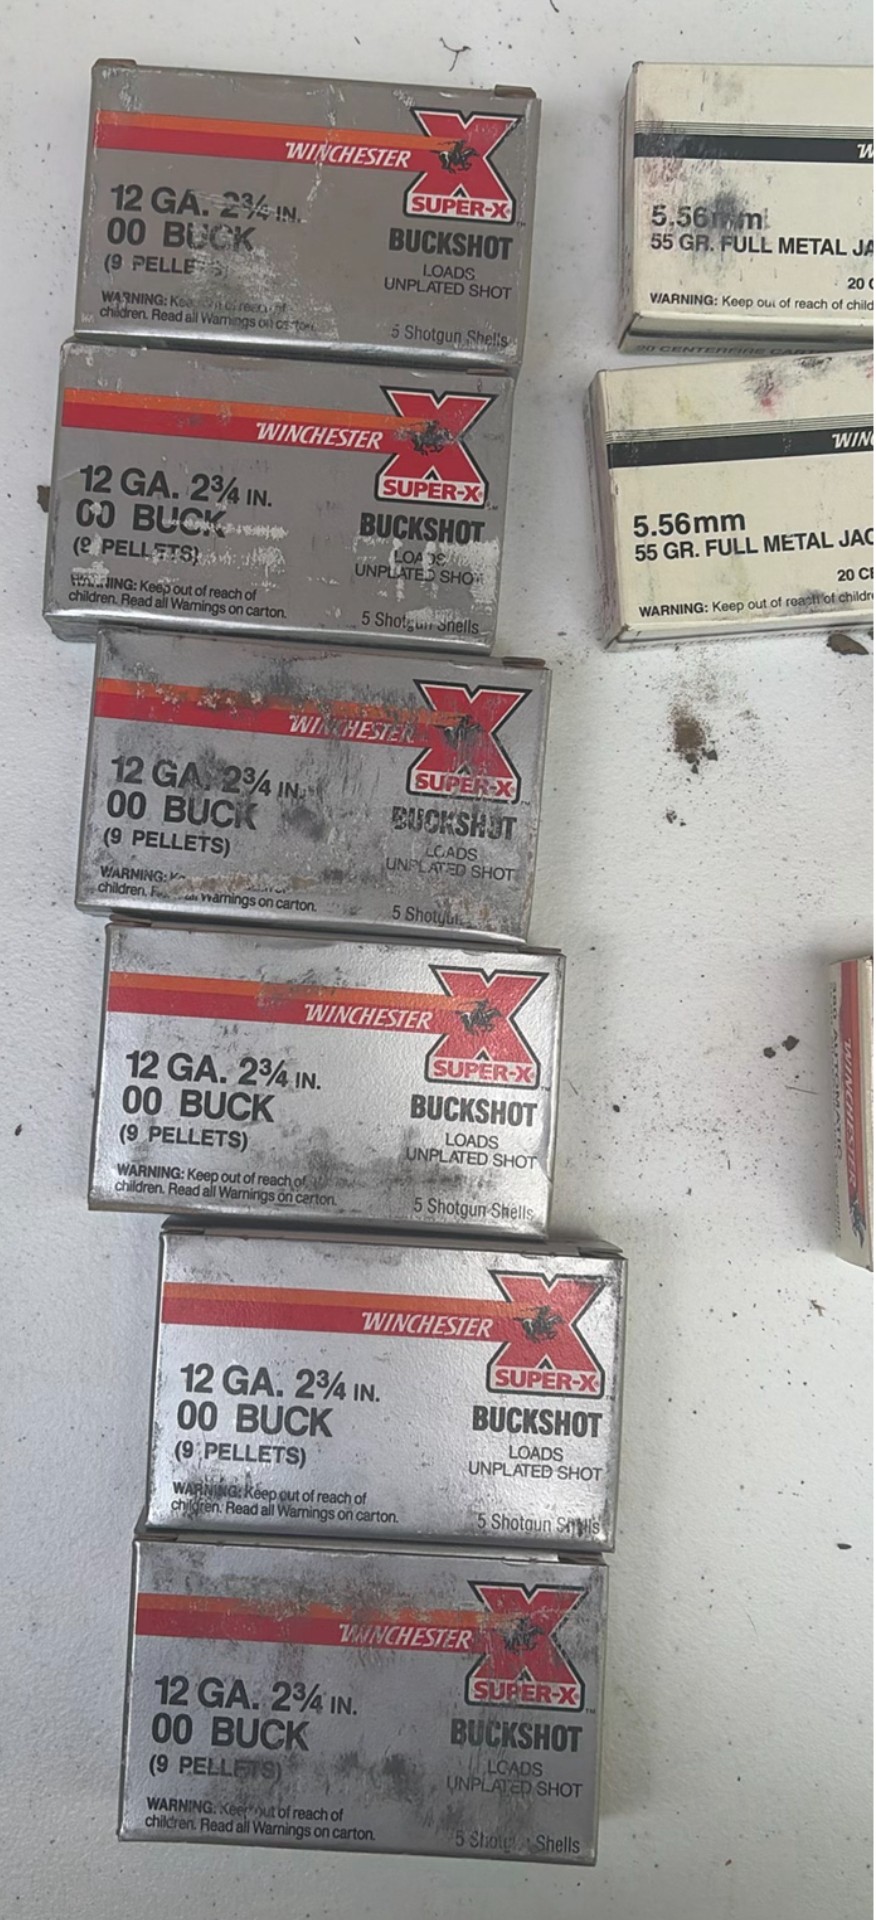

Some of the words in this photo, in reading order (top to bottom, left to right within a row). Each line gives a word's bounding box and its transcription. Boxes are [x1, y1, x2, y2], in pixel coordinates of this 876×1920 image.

[285, 142, 411, 168] WINCHESTER
[111, 184, 143, 211] 12
[151, 187, 209, 216] GA.
[276, 206, 300, 223] IN.
[412, 197, 507, 219] SUPER-X
[107, 217, 146, 245] 00
[163, 221, 256, 252] BUCK
[389, 228, 513, 260] BUCKSHOT
[651, 233, 673, 250] 55
[679, 235, 714, 252] GR.
[721, 236, 772, 253] FULL
[779, 238, 847, 256] METAL
[104, 254, 122, 273] (9
[423, 264, 475, 281] LOADS
[384, 277, 465, 295] UNPLATED
[469, 284, 512, 300] SHOT
[848, 278, 865, 289] 20
[650, 293, 718, 306] WARNING:
[722, 296, 754, 309] Keep
[779, 297, 791, 308] of
[795, 298, 827, 310] reach
[832, 299, 843, 311] of
[391, 324, 399, 338] 5
[404, 325, 462, 345] Shotgun
[256, 422, 384, 449] WINCHESTER
[80, 465, 112, 494] 12
[120, 468, 179, 499] GA.
[247, 489, 272, 507] IN.
[383, 479, 480, 502] SUPER-X
[76, 499, 115, 528] 00
[133, 504, 226, 538] BUCK
[360, 512, 485, 545] BUCKSHOT
[633, 512, 746, 538] 5.56mm
[102, 538, 199, 565] PELLETS)
[635, 544, 658, 561] 55
[664, 542, 699, 560] GR.
[706, 538, 758, 557] FULL
[764, 532, 833, 553] METAL
[355, 563, 435, 582] UNPLATED
[837, 568, 854, 582] 20
[140, 581, 171, 594] Keep
[173, 583, 192, 596] out
[195, 585, 207, 597] of
[209, 587, 242, 600] reach
[245, 588, 257, 600] of
[69, 591, 117, 606] children.
[121, 593, 152, 607] Read
[155, 596, 168, 609] all
[170, 597, 225, 616] Warnings
[228, 604, 245, 616] on
[248, 605, 287, 619] carton.
[639, 602, 708, 617] WARNING:
[712, 600, 744, 613] Keep
[748, 599, 767, 610] out
[771, 597, 782, 608] of
[824, 593, 836, 603] of
[111, 756, 144, 784] 12
[152, 760, 210, 791] GA.
[277, 781, 306, 799] IN.
[415, 773, 512, 798] SUPER-X
[107, 790, 146, 819] 00
[164, 795, 258, 830] BUCK
[392, 805, 517, 840] BUCKSHOT
[104, 827, 122, 848] (9
[132, 830, 230, 858] PELLETS)
[471, 865, 515, 881] SHOT
[304, 1004, 434, 1030] WINCHESTER
[126, 1050, 159, 1079] 12
[167, 1053, 227, 1084] GA.
[295, 1072, 321, 1090] IN.
[433, 1059, 533, 1083] SUPER-X
[122, 1085, 162, 1115] 00
[180, 1089, 275, 1122] BUCK
[411, 1094, 538, 1127] BUCKSHOT
[843, 1038, 857, 1188] WINCHESTER
[119, 1124, 138, 1145] (9
[149, 1126, 248, 1153] PELLETS)
[445, 1132, 499, 1149] LOADS
[405, 1147, 488, 1165] UNPLATED
[493, 1153, 538, 1170] SHOT
[117, 1164, 184, 1180] WARNING:
[187, 1168, 219, 1183] Keep
[221, 1171, 240, 1183] out
[243, 1172, 256, 1184] of
[258, 1173, 291, 1187] reach
[293, 1176, 306, 1187] of
[115, 1180, 164, 1195] children.
[168, 1183, 199, 1197] Read
[202, 1185, 216, 1198] all
[219, 1187, 275, 1205] Warnings
[278, 1193, 293, 1203] on
[296, 1193, 337, 1206] carton.
[414, 1197, 422, 1213] 5
[427, 1199, 486, 1220] Shotgun
[492, 1203, 533, 1220] Shells
[362, 1312, 493, 1338] WINCHESTER
[180, 1363, 214, 1394] 12
[222, 1365, 283, 1397] GA.
[354, 1384, 380, 1402] IN.
[495, 1369, 597, 1393] SUPER-X
[177, 1399, 217, 1431] 00
[236, 1403, 333, 1438] BUCK
[472, 1405, 603, 1438] BUCKSHOT
[175, 1440, 194, 1462] (9
[204, 1442, 306, 1469] PELLETS)
[509, 1445, 563, 1462] LOADS
[469, 1462, 553, 1479] UNPLATED
[557, 1466, 603, 1481] SHOT
[478, 1513, 487, 1530] 5
[491, 1514, 551, 1533] Shotgun
[339, 1623, 473, 1649] WINCHESTER
[155, 1675, 190, 1706] 12
[197, 1677, 259, 1710] GA.
[330, 1697, 357, 1715] IN.
[473, 1681, 576, 1705] SUPER-X
[152, 1712, 192, 1745] 00
[212, 1716, 310, 1751] BUCK
[451, 1718, 583, 1753] BUCKSHOT
[150, 1754, 168, 1777] (9
[179, 1756, 282, 1783] PELLETS)
[487, 1760, 543, 1777] LOADS
[446, 1776, 532, 1795] UNPLATED
[536, 1781, 583, 1798] SHOT
[145, 1816, 197, 1831] children.
[200, 1818, 233, 1833] Read
[236, 1821, 250, 1833] all
[253, 1823, 310, 1840] Warnings
[314, 1829, 329, 1838] on
[333, 1829, 375, 1841] carton.
[455, 1831, 464, 1847] 5
[537, 1834, 580, 1854] Shells
